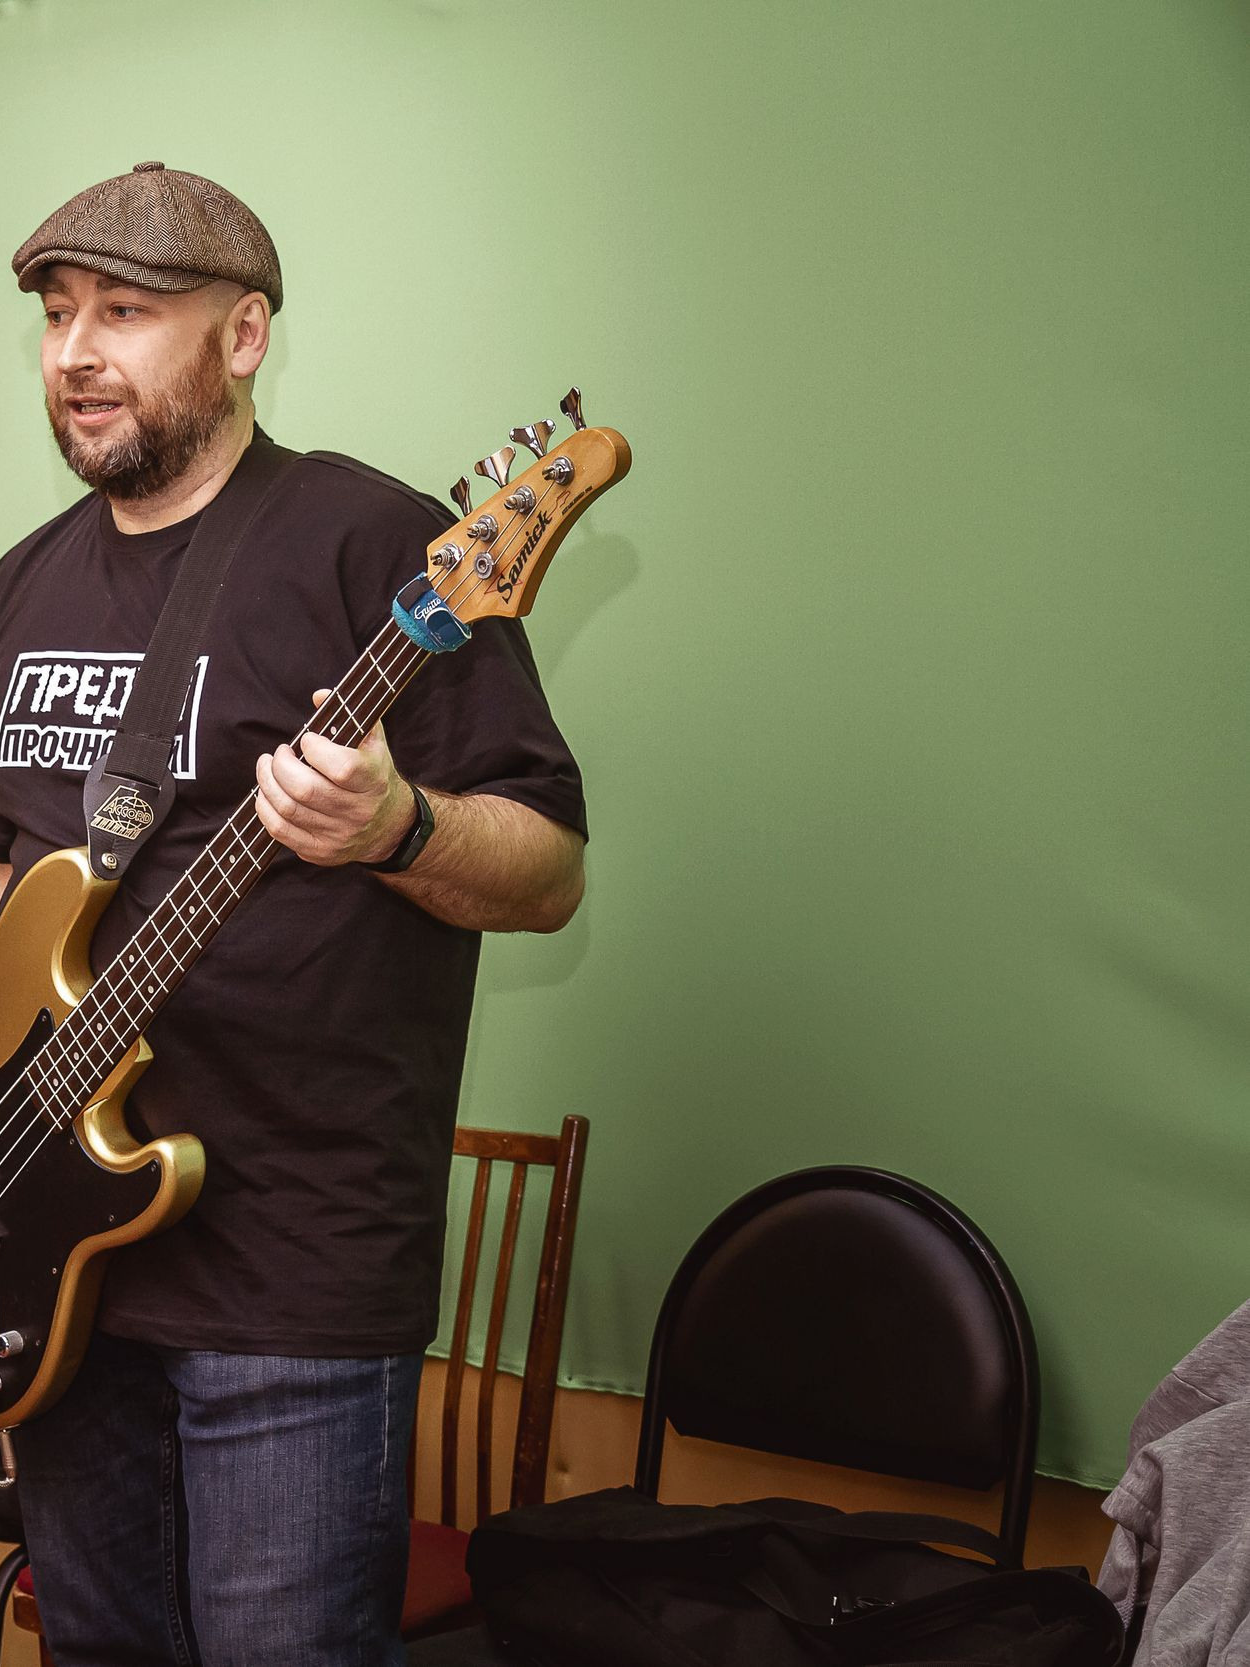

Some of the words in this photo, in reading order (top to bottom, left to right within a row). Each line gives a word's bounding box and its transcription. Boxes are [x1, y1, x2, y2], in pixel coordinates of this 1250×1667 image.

[496, 510, 556, 605] Samick
[414, 598, 442, 620] Guitto
[9, 663, 196, 725] ПРЕД
[103, 797, 152, 825] ACCORD
